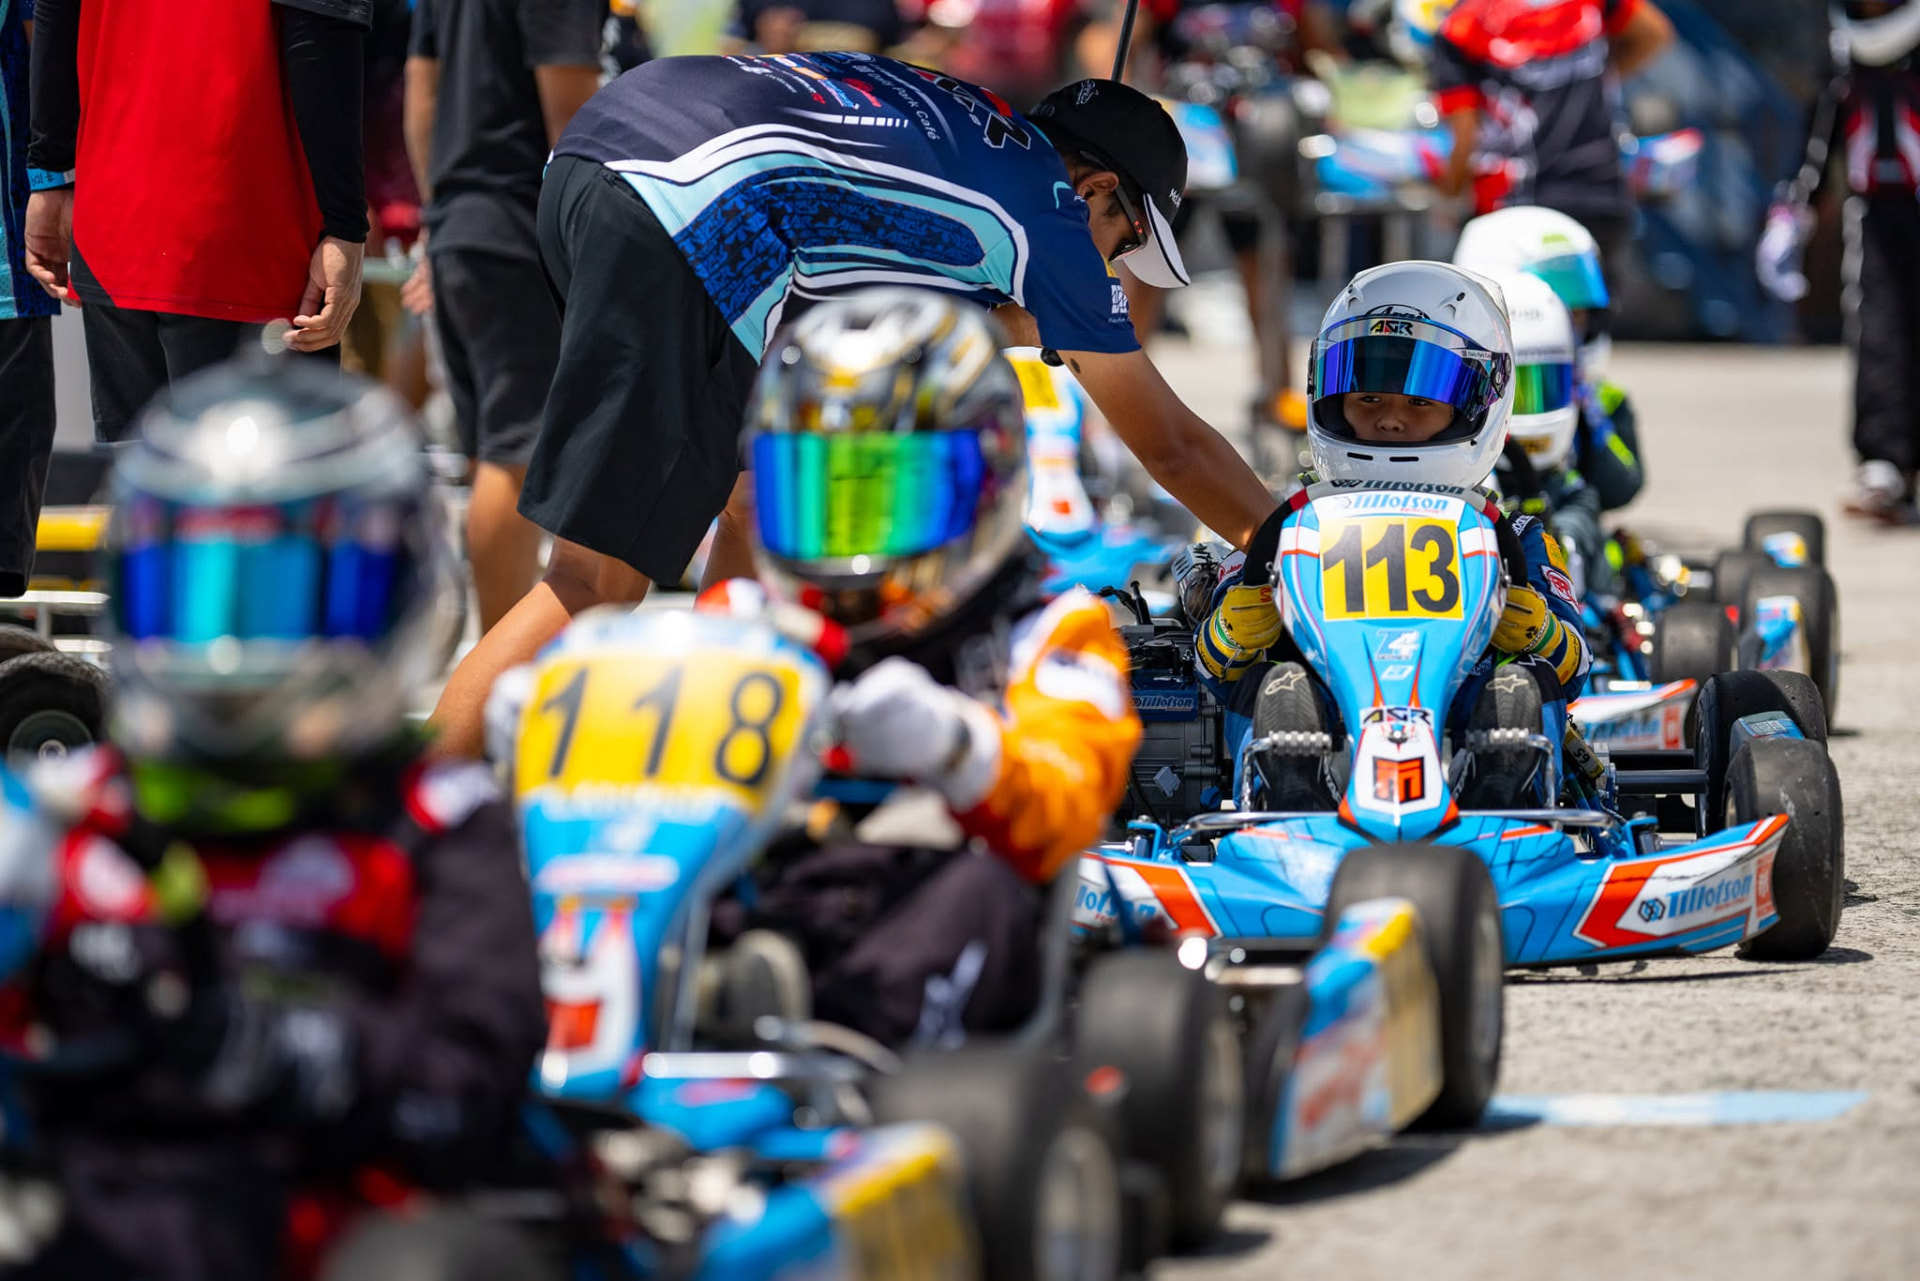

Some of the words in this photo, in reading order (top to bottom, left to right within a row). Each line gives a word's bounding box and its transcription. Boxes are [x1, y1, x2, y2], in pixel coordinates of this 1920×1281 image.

[892, 86, 920, 108] Park
[915, 110, 941, 141] Café
[1353, 494, 1449, 510] Tillotson
[1322, 523, 1460, 613] 113
[541, 665, 784, 787] 118
[1141, 696, 1193, 708] Tillotson
[1665, 873, 1753, 919] Tillotson
